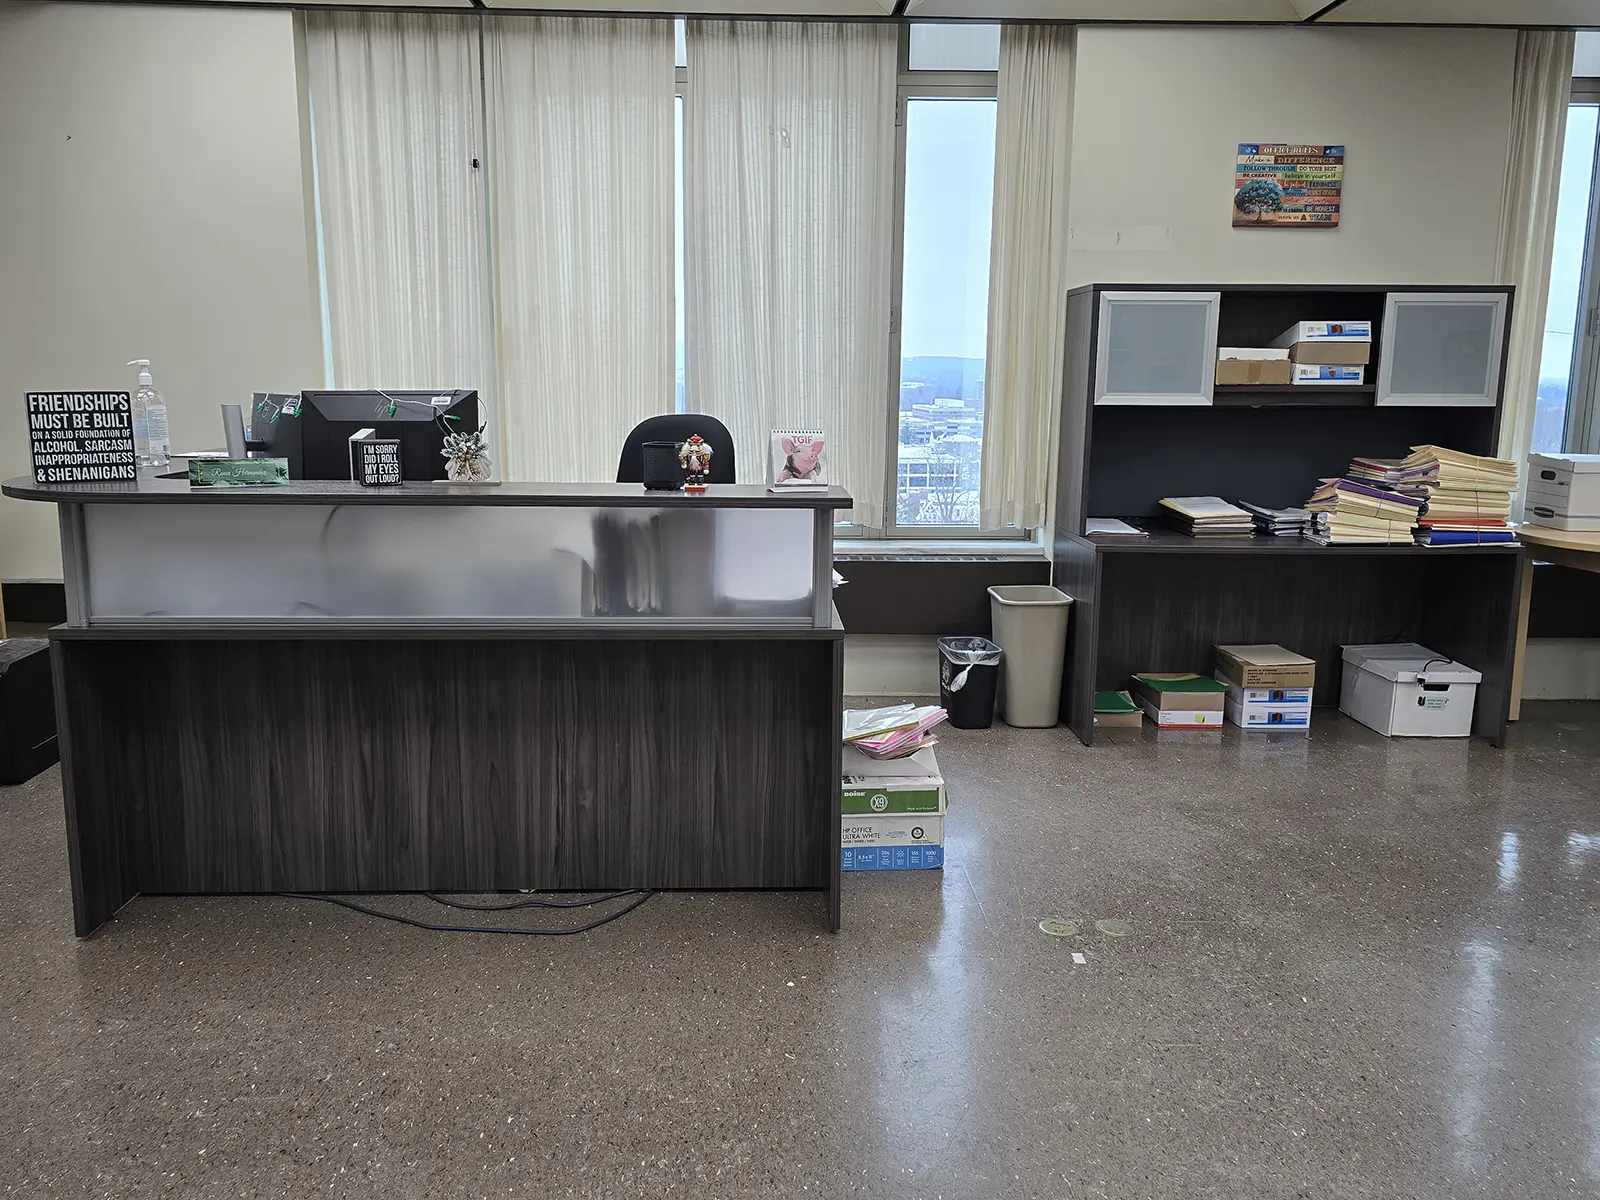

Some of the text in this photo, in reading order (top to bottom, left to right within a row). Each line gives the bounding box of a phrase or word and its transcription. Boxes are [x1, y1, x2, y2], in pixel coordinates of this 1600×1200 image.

[1300, 213, 1307, 221] A
[1308, 213, 1332, 221] TEAM
[28, 394, 129, 411] FRIENDSHIPS
[30, 413, 69, 429] MUST
[73, 413, 91, 428] BE
[93, 412, 129, 428] BUILT
[32, 431, 43, 440] ON
[44, 430, 50, 439] A
[51, 430, 74, 439] SOLID
[75, 429, 120, 439] FOUNDATION
[122, 429, 131, 438] OF
[791, 435, 813, 444] TGIF
[34, 439, 132, 453] ALCOHOL, SARCASM
[363, 444, 397, 454] I'M SORRY
[35, 452, 134, 466] INAPPROPRIATENESS
[364, 454, 398, 463] DID I ROLL
[37, 465, 135, 482] & SHENANIGANS
[365, 463, 399, 474] MY EYES
[365, 474, 399, 483] OUT LOUD?
